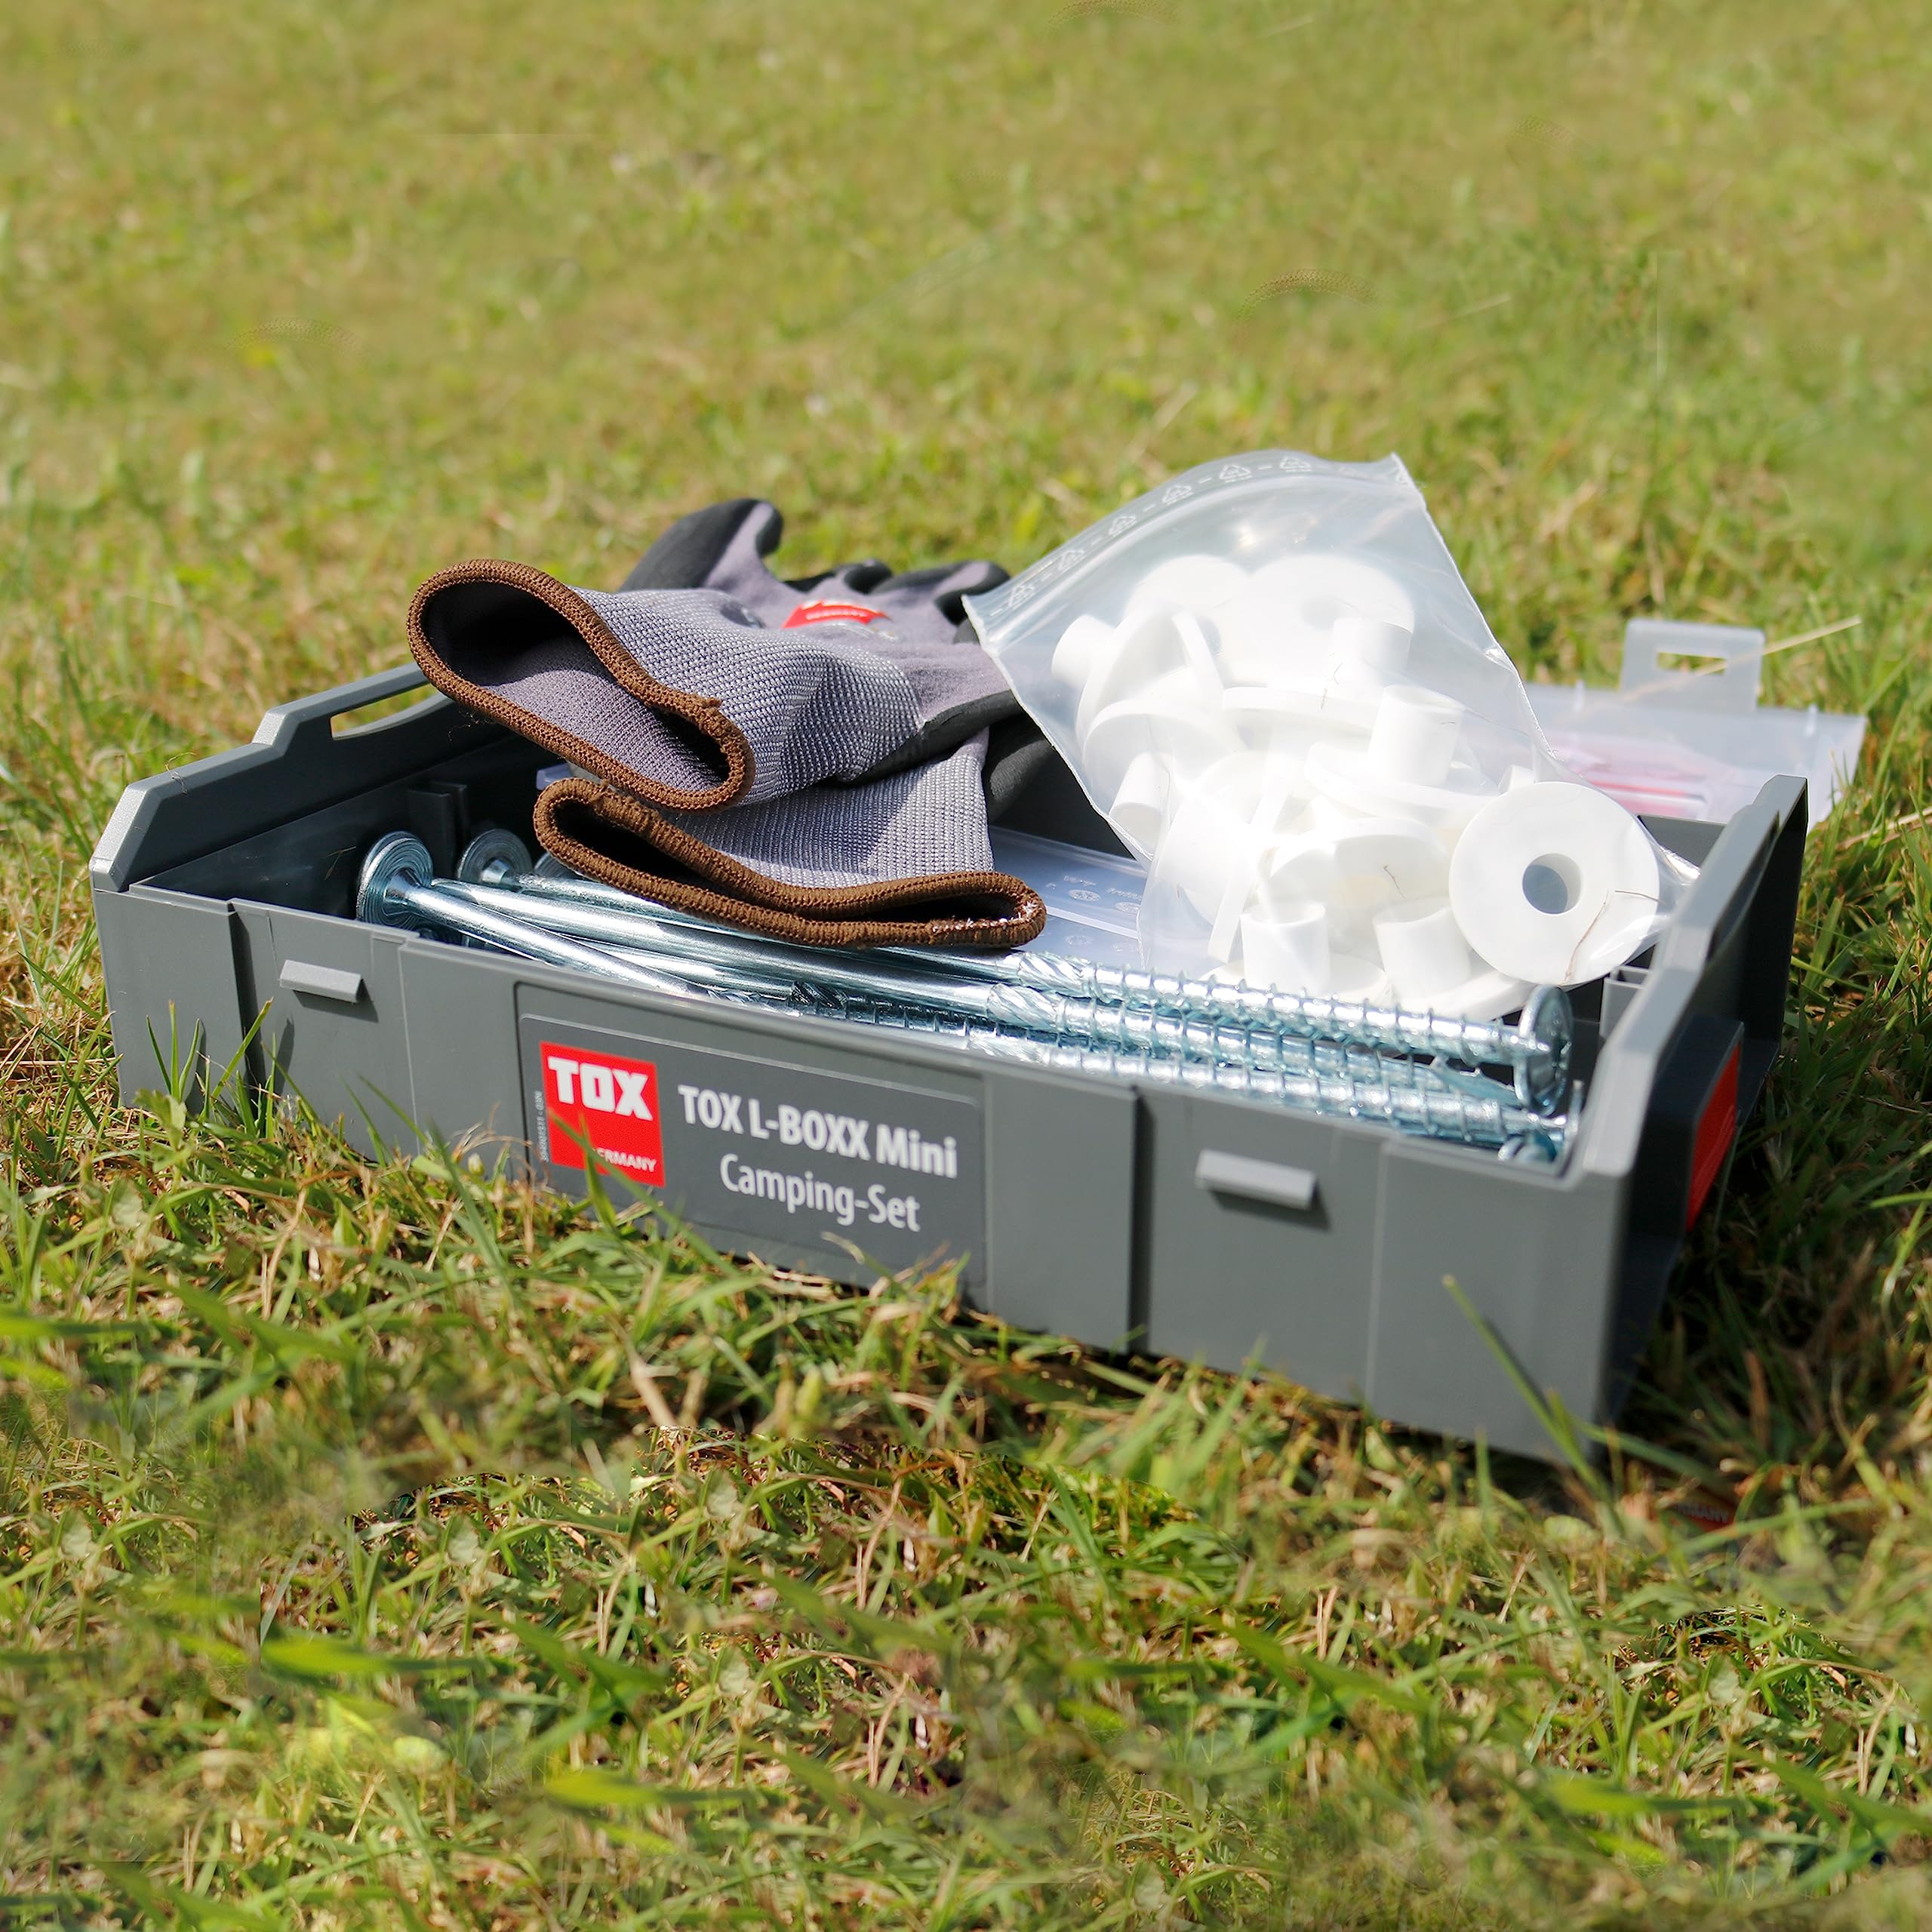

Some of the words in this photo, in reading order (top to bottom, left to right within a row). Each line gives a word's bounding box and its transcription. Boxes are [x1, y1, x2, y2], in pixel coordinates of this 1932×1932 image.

[547, 1056, 653, 1121] TOX
[593, 1146, 657, 1172] ERMANY
[678, 1084, 743, 1134] TOX
[748, 1099, 871, 1161] L-BOXX
[876, 1124, 958, 1179] Mini
[720, 1154, 921, 1232] Camping-Set
